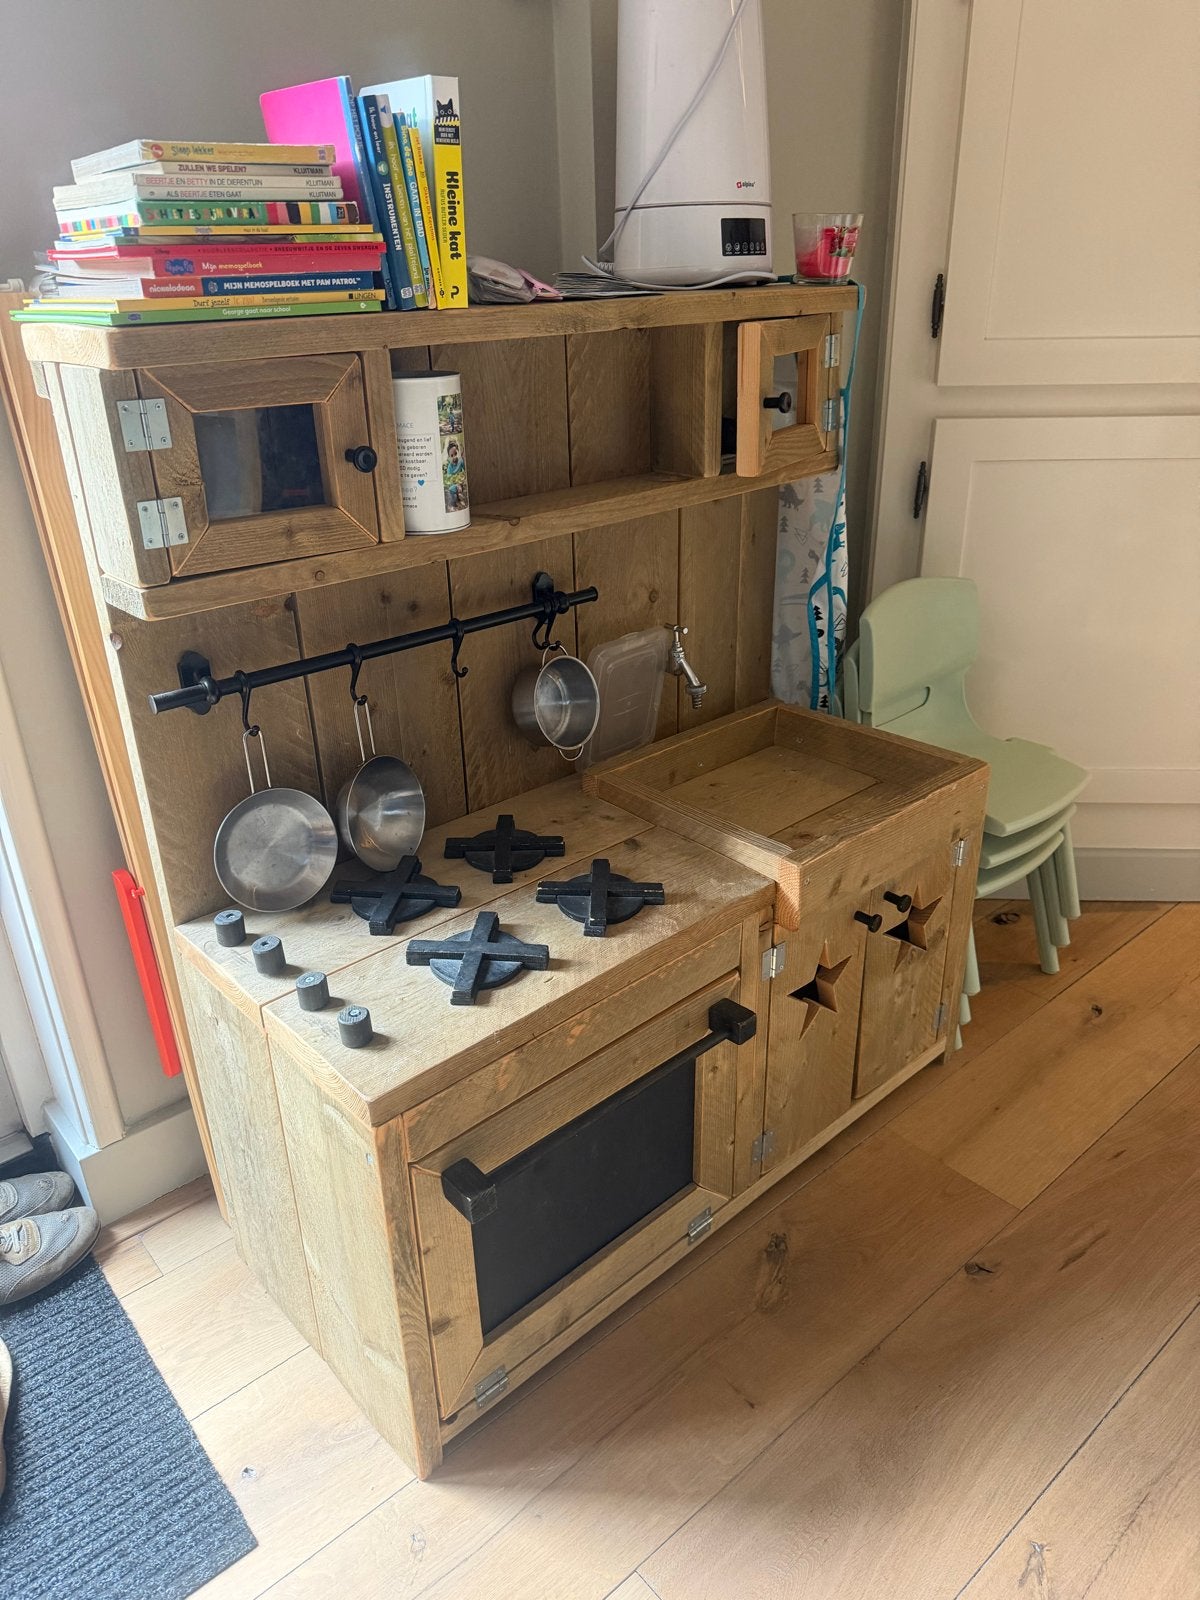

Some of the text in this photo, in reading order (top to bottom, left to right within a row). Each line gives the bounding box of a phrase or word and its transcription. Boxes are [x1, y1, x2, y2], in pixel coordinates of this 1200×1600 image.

[178, 164, 247, 173] ZULLEN WE SPELEN?
[145, 176, 175, 184] BEERTJE
[187, 178, 208, 186] BETTY
[227, 178, 263, 186] DIERENTUIN
[410, 181, 420, 205] GAAT
[382, 183, 402, 251] INSTRUMENTEN
[414, 207, 422, 217] IN
[445, 171, 462, 260] Kleine kat
[416, 220, 424, 238] BAD
[407, 243, 420, 279] platteland
[202, 262, 263, 272] Mijn memospelboek
[149, 284, 196, 293] nickelodeon
[224, 281, 243, 290] MIJN
[244, 278, 300, 288] MEMOSPELBOEK
[300, 278, 315, 286] MET
[316, 278, 331, 286] PAW
[194, 300, 210, 308] Durf
[222, 308, 244, 316] George
[244, 308, 259, 316] gaat
